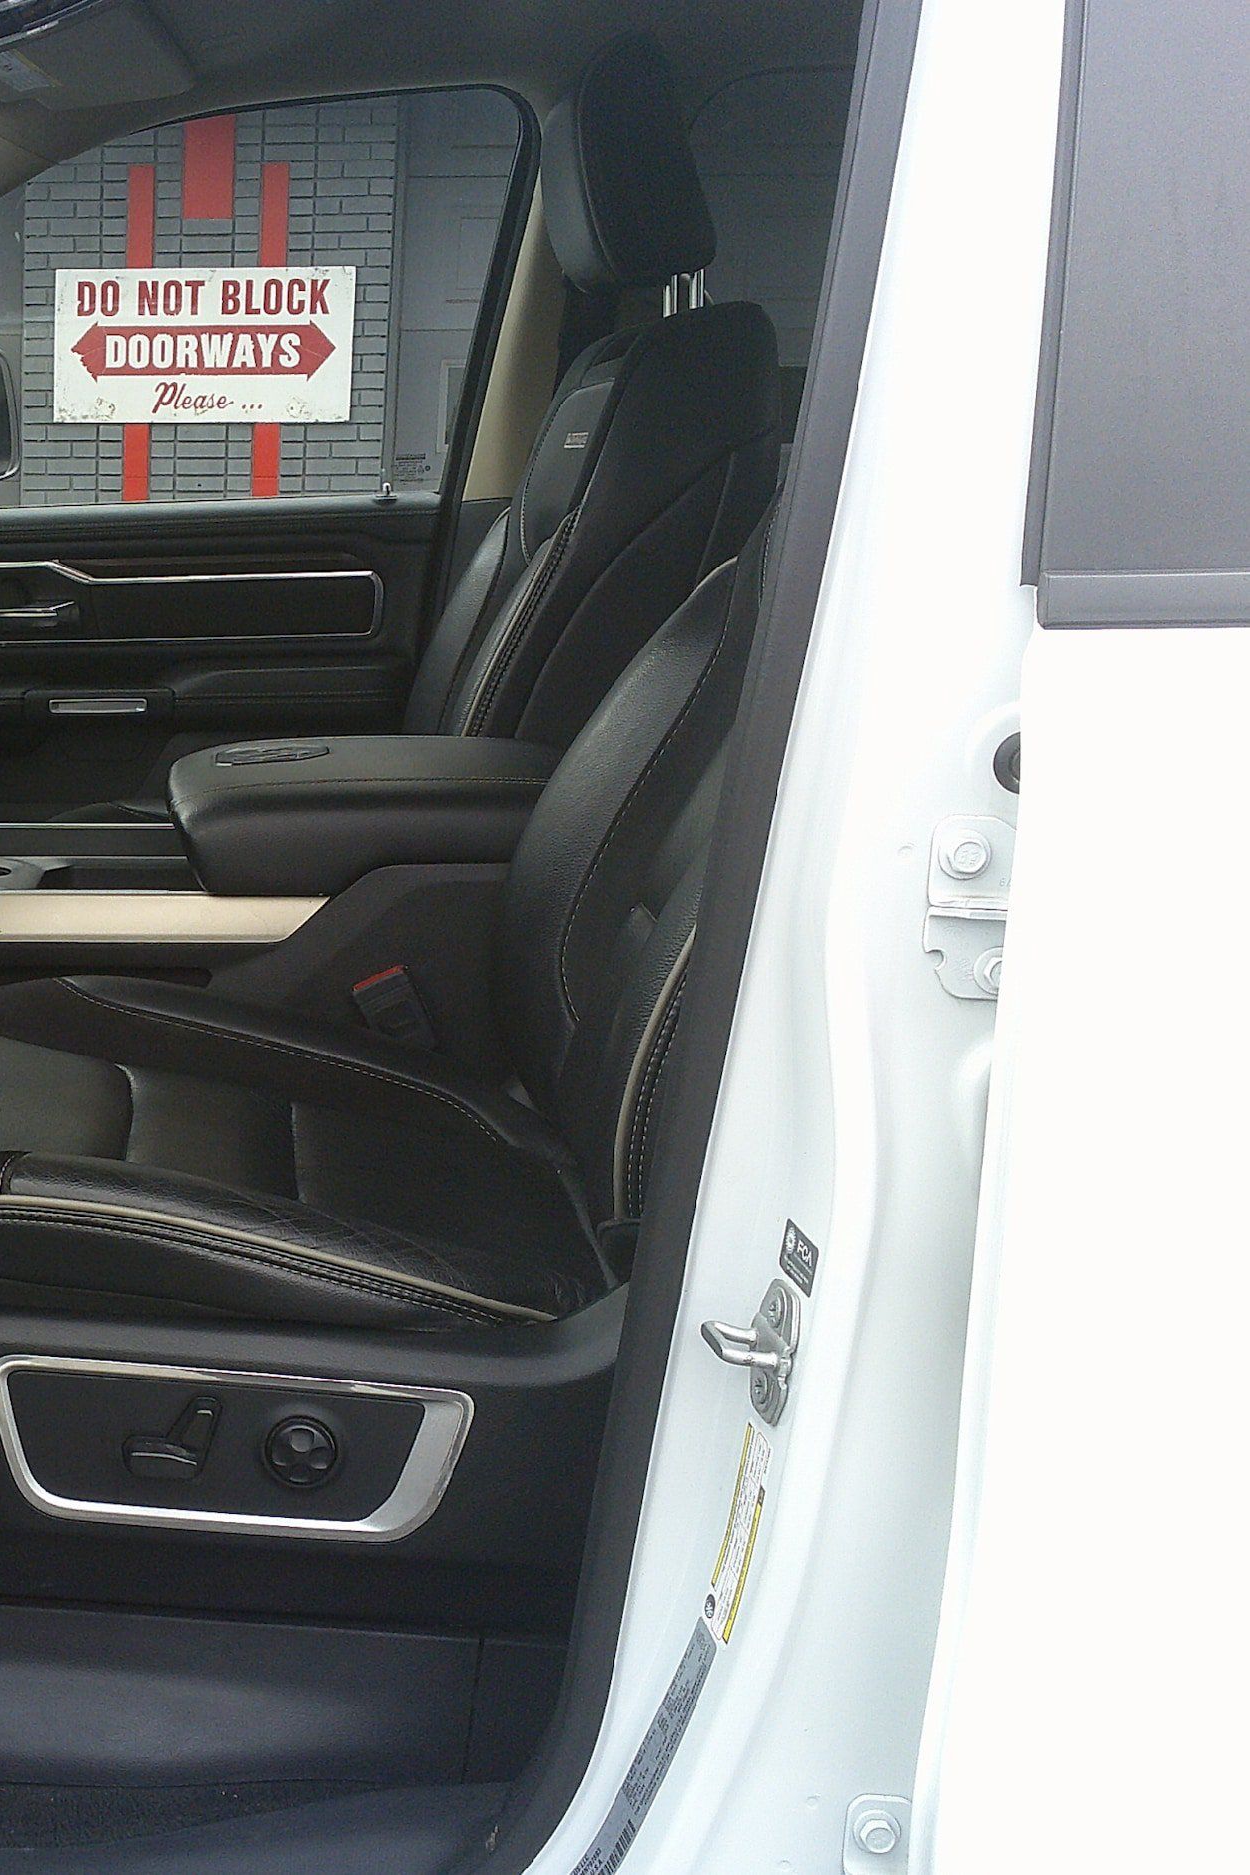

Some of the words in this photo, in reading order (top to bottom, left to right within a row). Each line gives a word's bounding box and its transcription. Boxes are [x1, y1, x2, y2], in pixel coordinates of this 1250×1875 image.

[77, 280, 120, 317] DO
[138, 280, 205, 316] NOT
[221, 278, 331, 315] BLOCK
[105, 332, 302, 369] DOORWAYS
